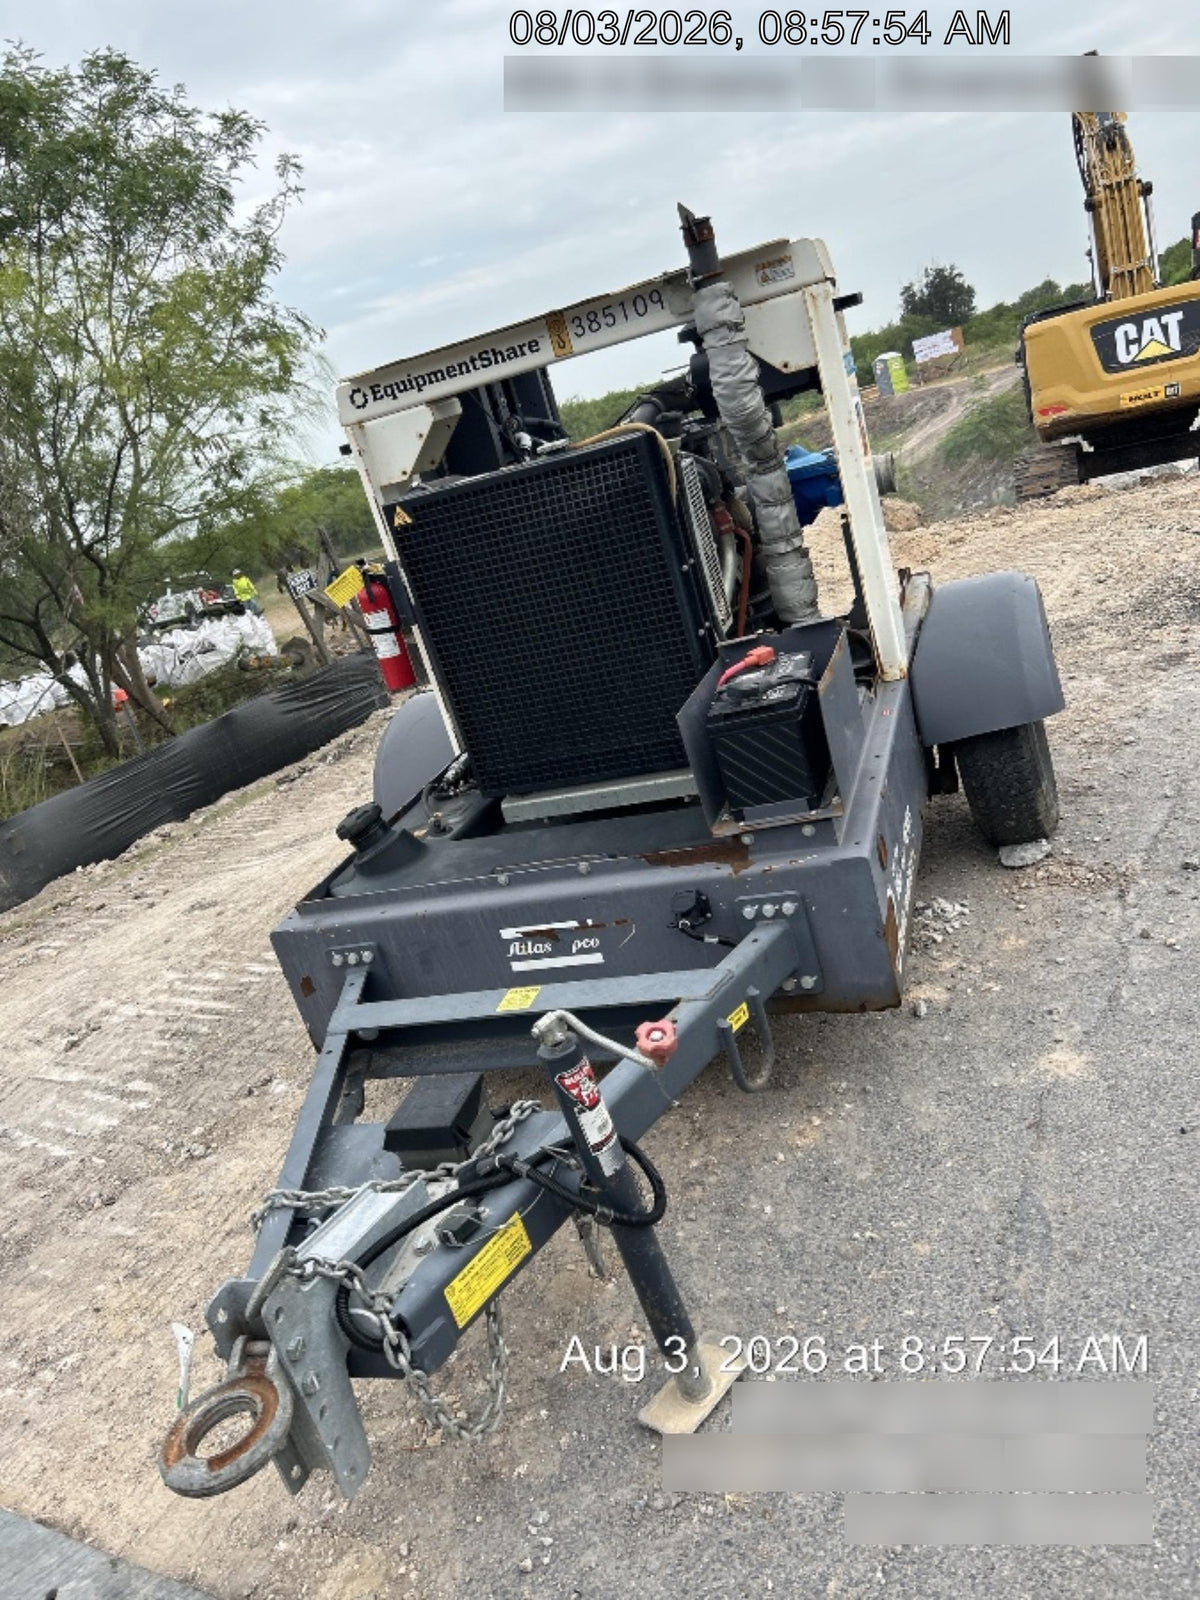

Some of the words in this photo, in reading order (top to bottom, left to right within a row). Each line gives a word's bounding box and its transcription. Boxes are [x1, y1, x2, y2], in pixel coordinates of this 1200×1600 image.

[369, 337, 541, 403] EquipmentShare
[571, 288, 664, 338] 385109
[1114, 310, 1184, 364] CAT
[506, 940, 552, 957] Atlas
